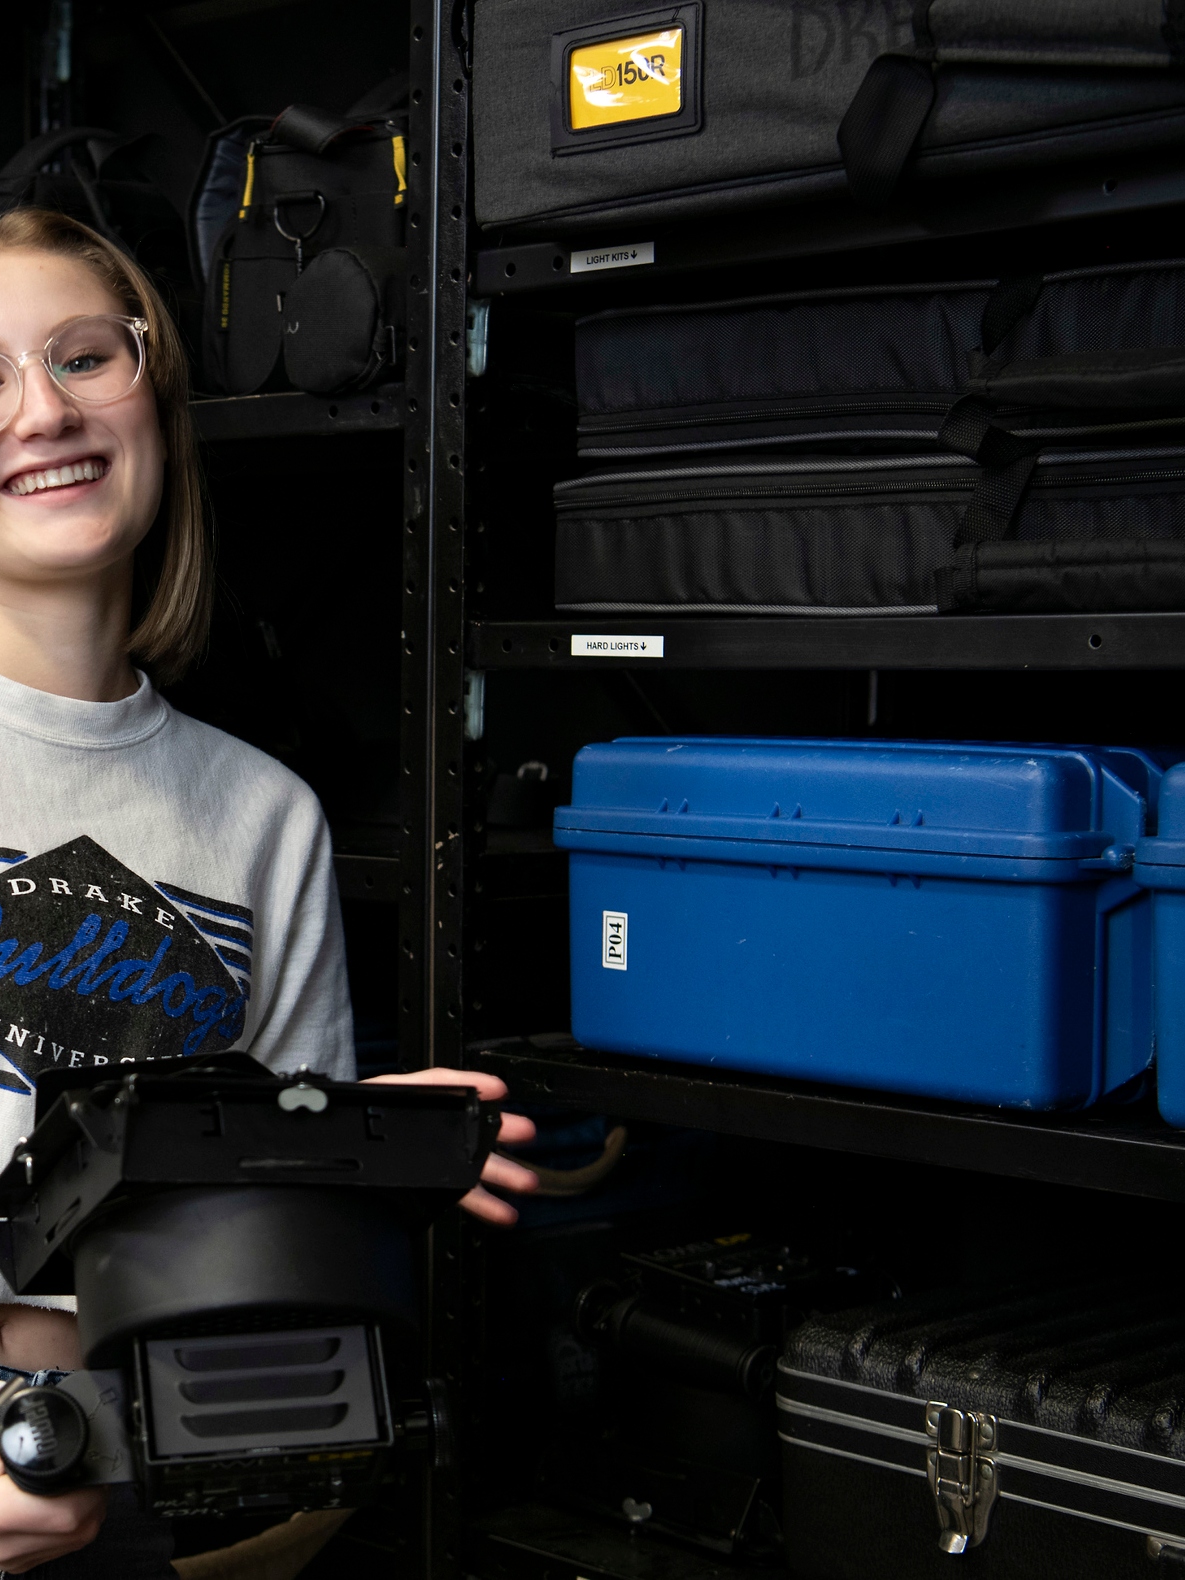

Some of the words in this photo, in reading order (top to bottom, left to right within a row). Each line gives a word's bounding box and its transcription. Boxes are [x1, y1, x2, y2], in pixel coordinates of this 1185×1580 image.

[586, 253, 610, 265] LIGHT
[611, 251, 630, 262] KITS
[586, 641, 609, 650] HARD
[610, 642, 639, 651] LIGHTS
[7, 877, 176, 930] DRAKE
[608, 922, 622, 959] P04
